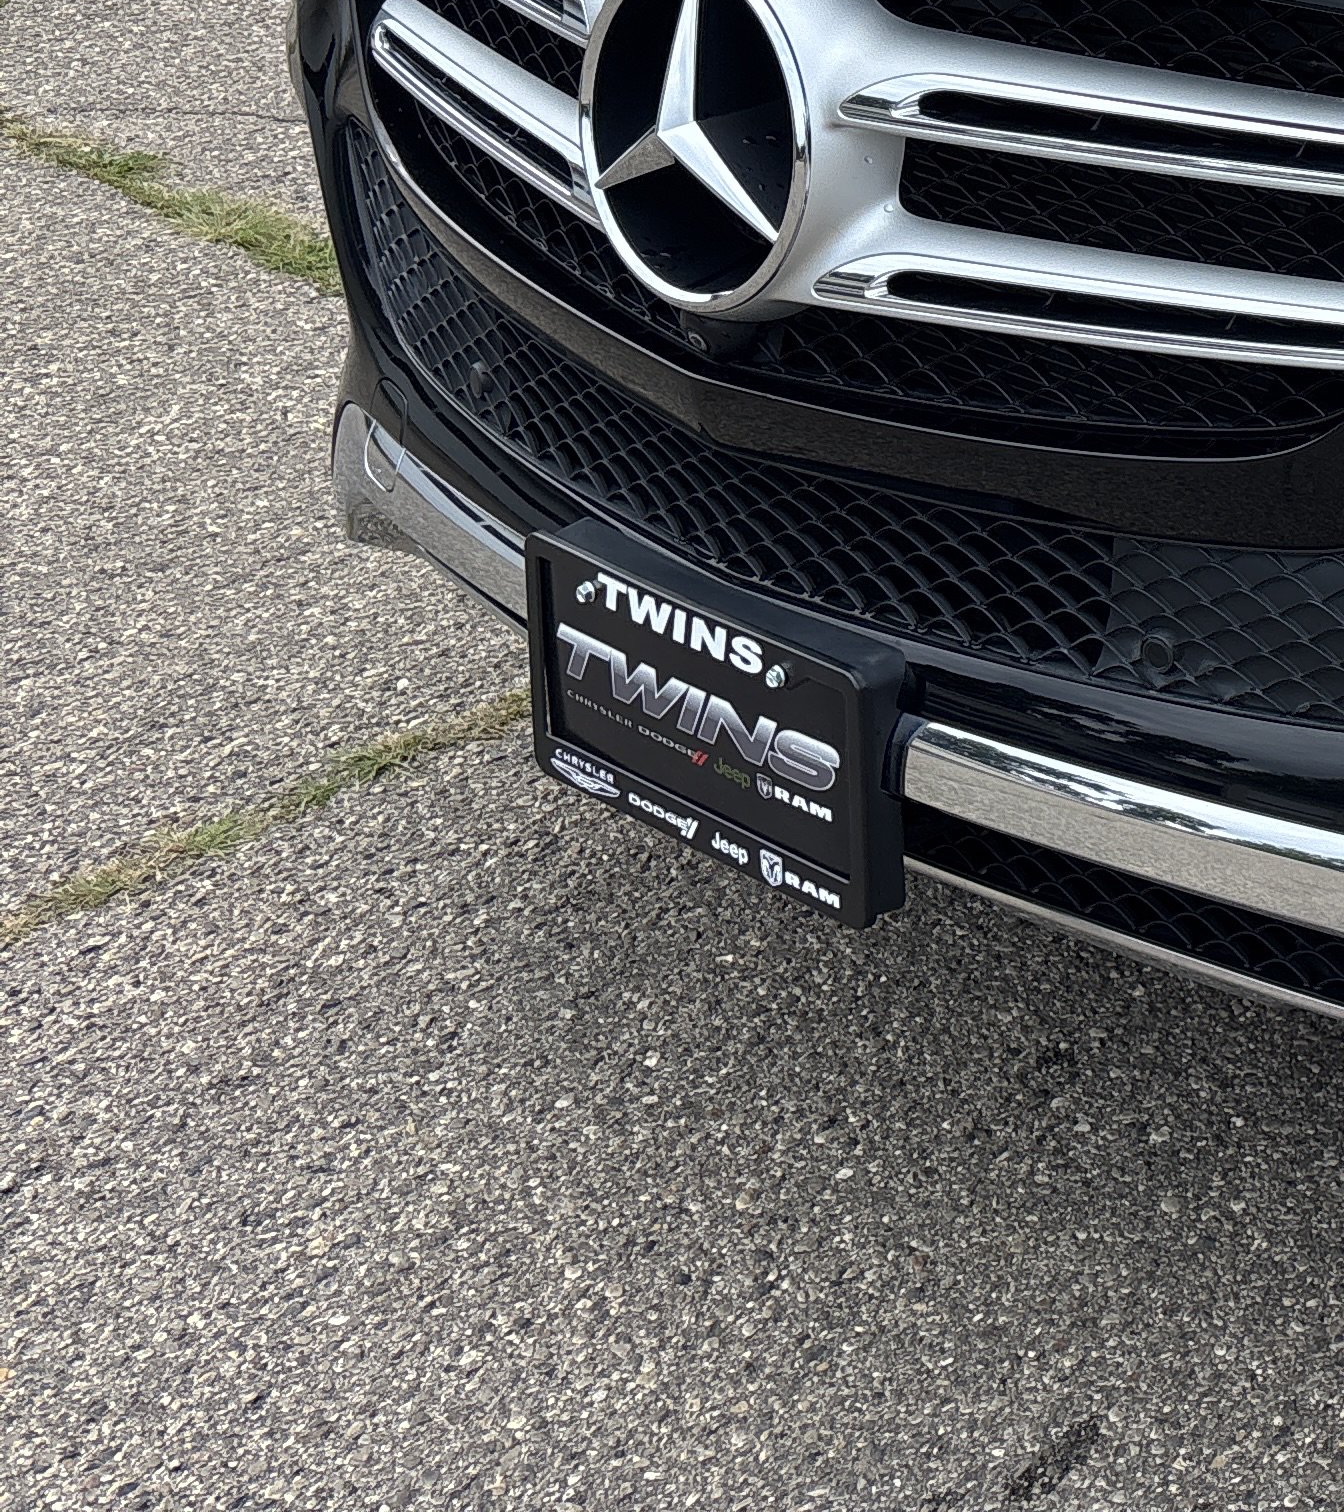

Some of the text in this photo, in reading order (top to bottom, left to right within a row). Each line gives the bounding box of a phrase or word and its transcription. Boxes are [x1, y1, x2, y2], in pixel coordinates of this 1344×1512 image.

[597, 572, 764, 675] TWINS
[556, 622, 840, 791] TWINS
[567, 689, 833, 822] CHRYSLER DODGE Jeep RAM
[555, 748, 841, 909] CHRYSLER DODGE Jeep RAM
